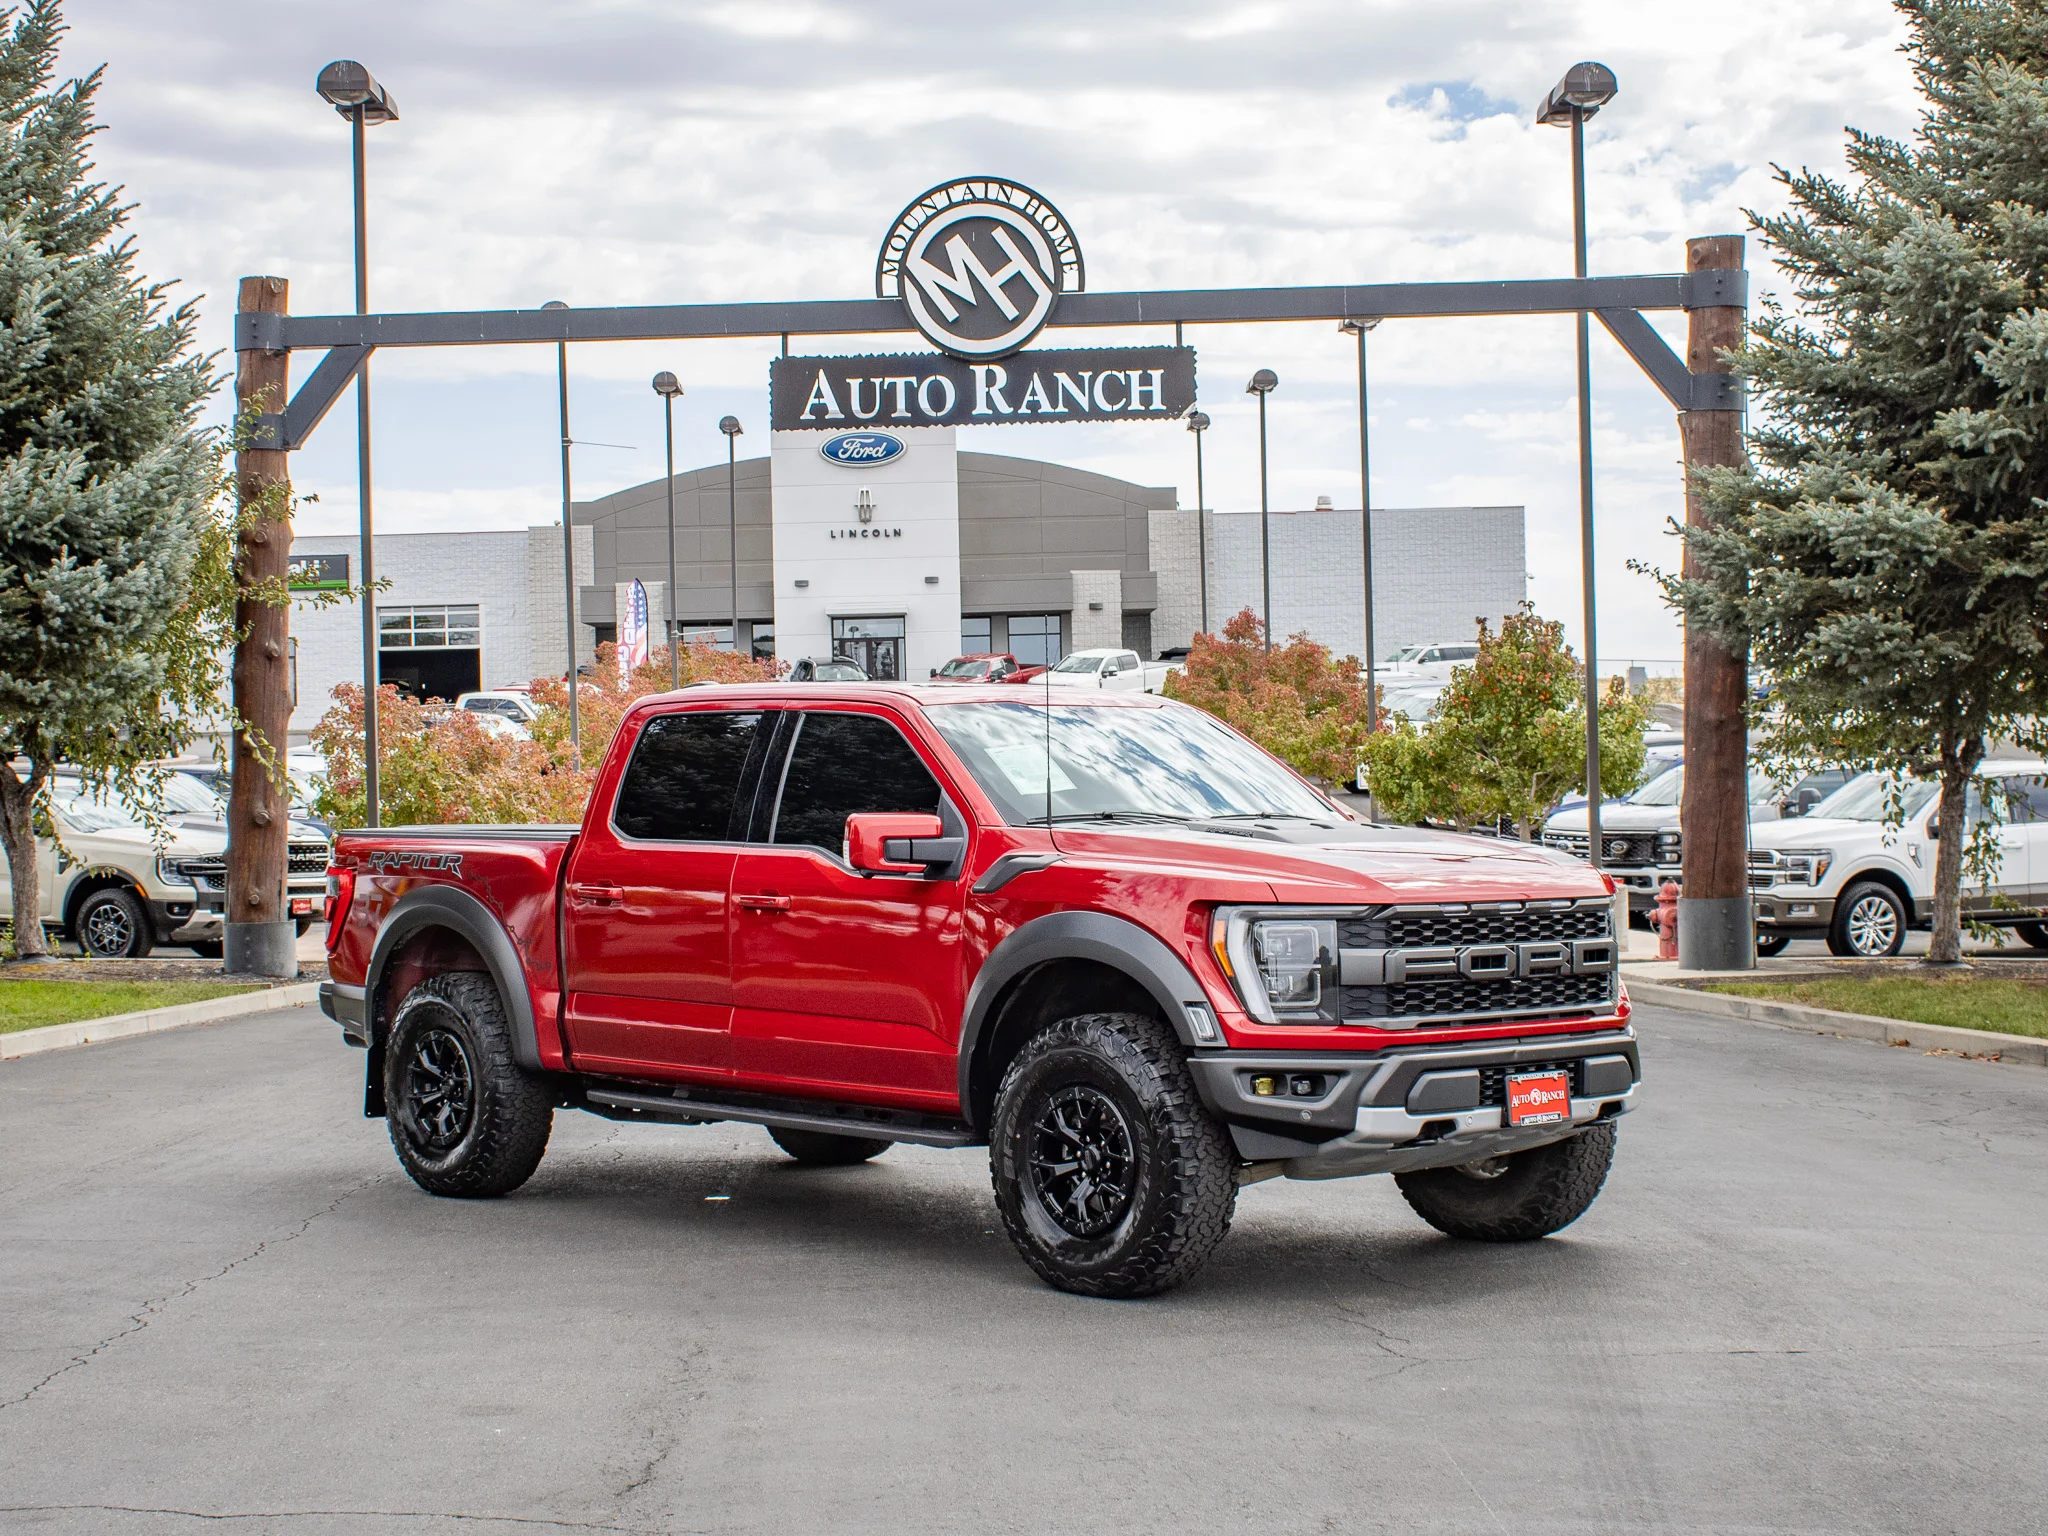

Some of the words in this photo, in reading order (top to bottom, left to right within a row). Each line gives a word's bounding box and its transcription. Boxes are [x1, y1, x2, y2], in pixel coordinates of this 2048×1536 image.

[881, 182, 1014, 277] MOUNTAIN
[1025, 197, 1079, 274] HOME
[800, 368, 957, 421] AUTO
[970, 364, 1167, 416] RANCH
[838, 438, 888, 460] Ford
[830, 527, 902, 539] LINCOLN
[368, 852, 463, 879] RAPTOR
[1384, 940, 1619, 985] FORD
[1511, 1094, 1531, 1107] AUTO
[1541, 1090, 1565, 1104] RANCH
